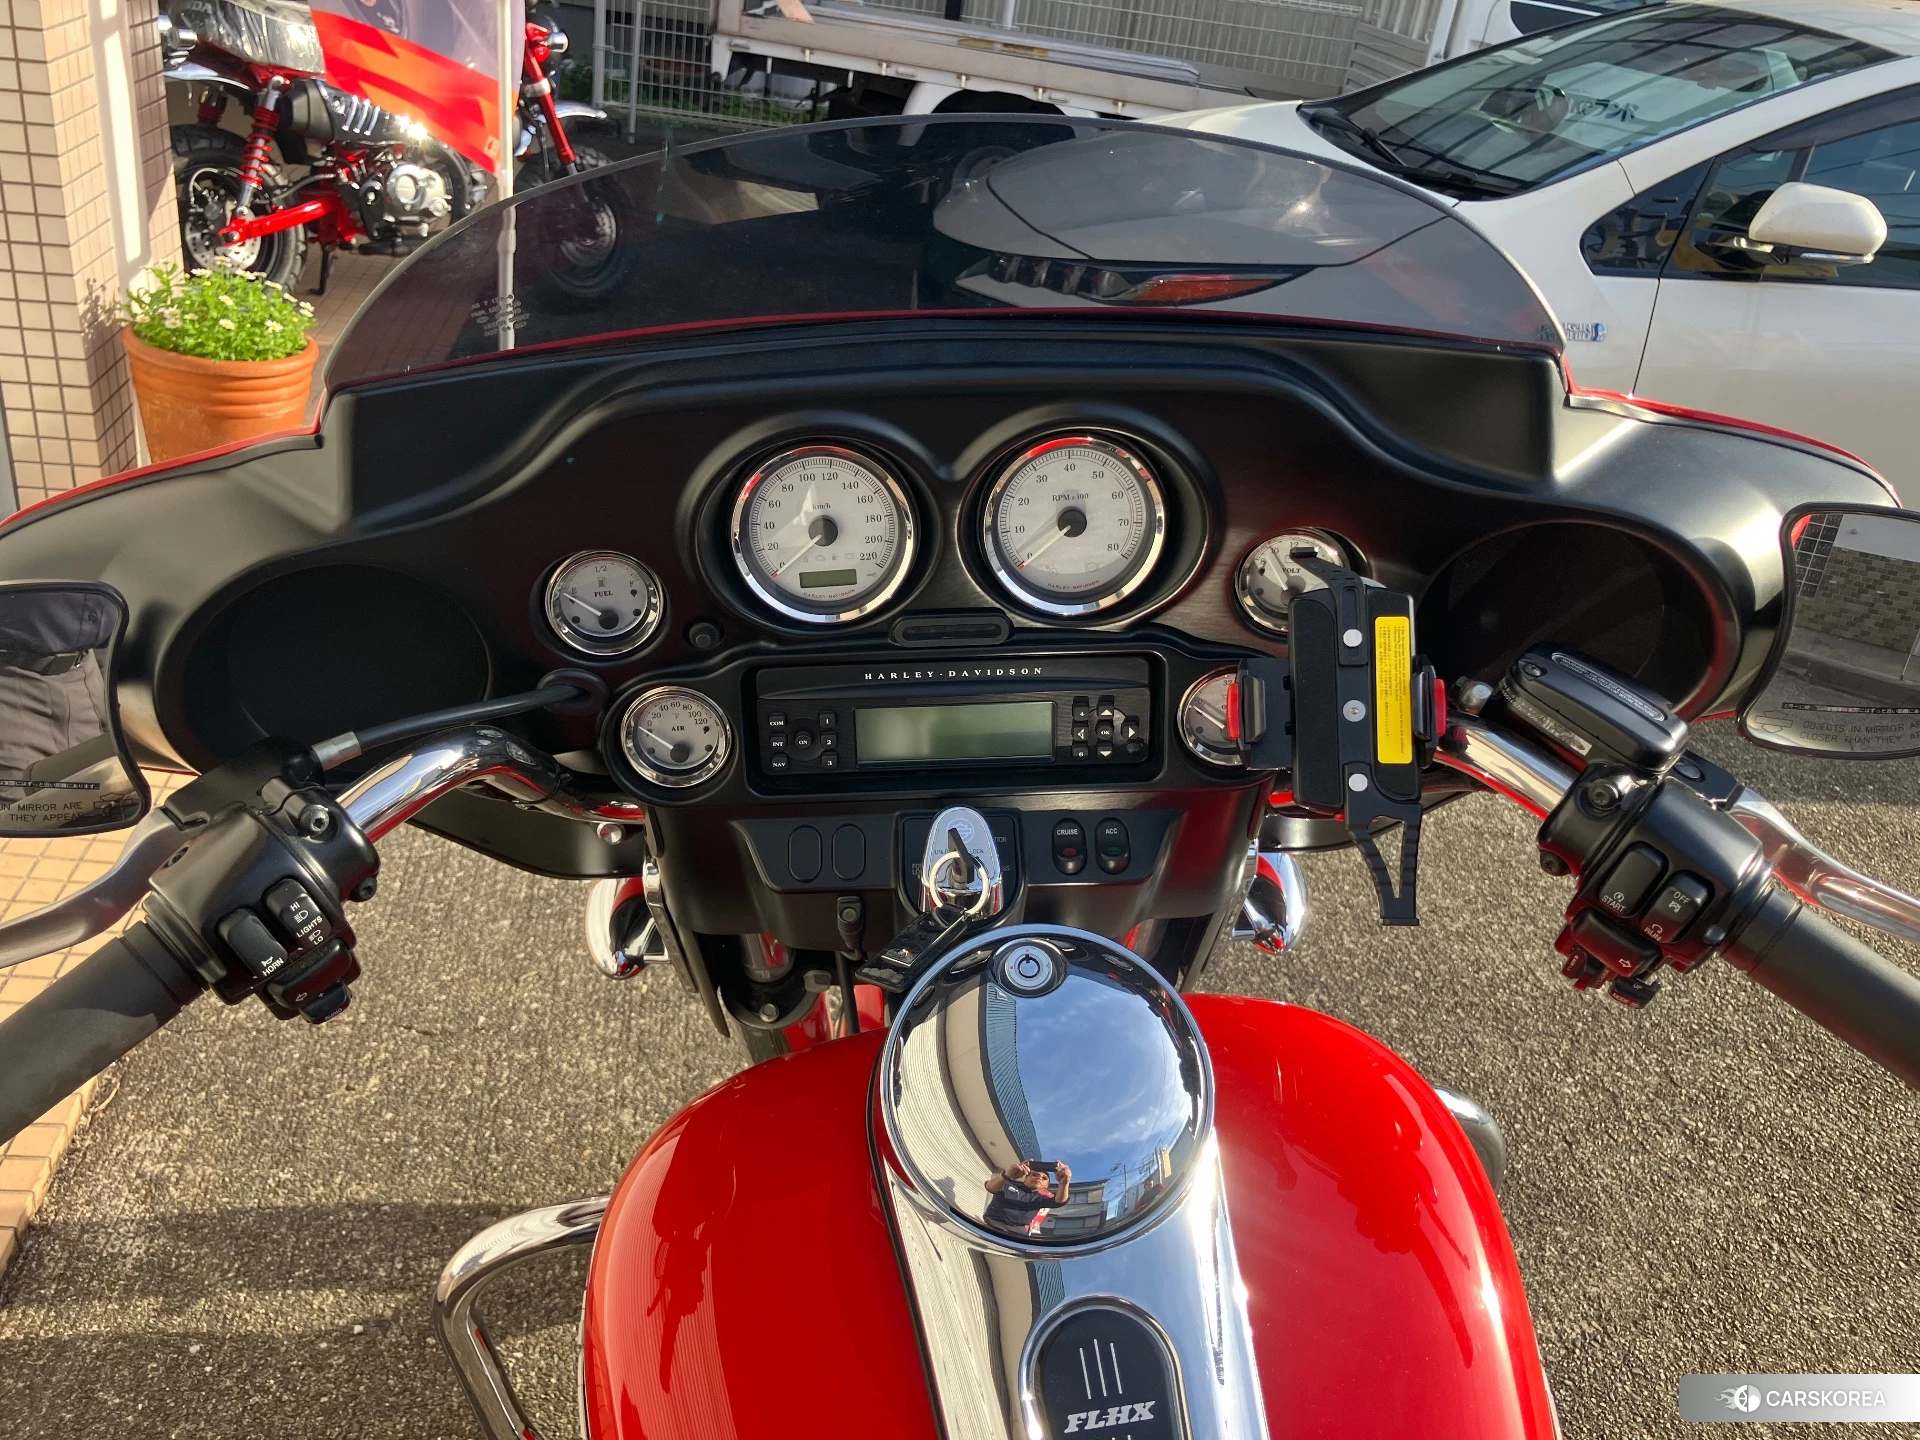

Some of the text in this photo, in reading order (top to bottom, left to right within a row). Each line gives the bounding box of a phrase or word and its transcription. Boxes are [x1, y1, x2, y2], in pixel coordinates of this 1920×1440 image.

[1064, 464, 1076, 472] 40
[798, 473, 816, 482] 100
[822, 472, 838, 481] 120
[1036, 475, 1048, 483] 30
[1092, 471, 1104, 479] 50
[781, 484, 794, 492] 80
[842, 482, 859, 490] 140
[856, 495, 874, 504] 160
[1052, 494, 1070, 502] RPM
[1111, 492, 1124, 500] 60
[768, 500, 781, 509] 60
[812, 502, 832, 510] km/h
[1018, 498, 1030, 506] 20
[865, 514, 882, 523] 180
[1118, 518, 1129, 527] 70
[763, 521, 775, 530] 40
[1014, 526, 1025, 534] 10
[864, 535, 883, 544] 200
[767, 542, 779, 550] 20
[1107, 543, 1119, 552] 80
[859, 552, 878, 561] 220
[595, 564, 608, 573] 1/2
[864, 668, 1042, 680] HARLEY-DAVIDSON
[1802, 720, 1845, 732] OBJECTS
[1866, 724, 1904, 734] MIRROR
[1800, 732, 1838, 742] CLOSER
[1844, 736, 1870, 744] THAN
[1875, 736, 1901, 744] THEY
[18, 803, 56, 812] MIRROR
[63, 802, 82, 810] ARE
[10, 814, 37, 822] THEY
[1056, 828, 1078, 836] CRUISE
[1673, 891, 1690, 904] OFF
[290, 901, 300, 912] HI
[1602, 894, 1626, 912] START
[296, 916, 323, 938] LIGHTS
[1644, 926, 1662, 942] RUN
[314, 936, 324, 946] LO
[262, 957, 284, 976] HORN
[1064, 1400, 1156, 1434] FLHX
